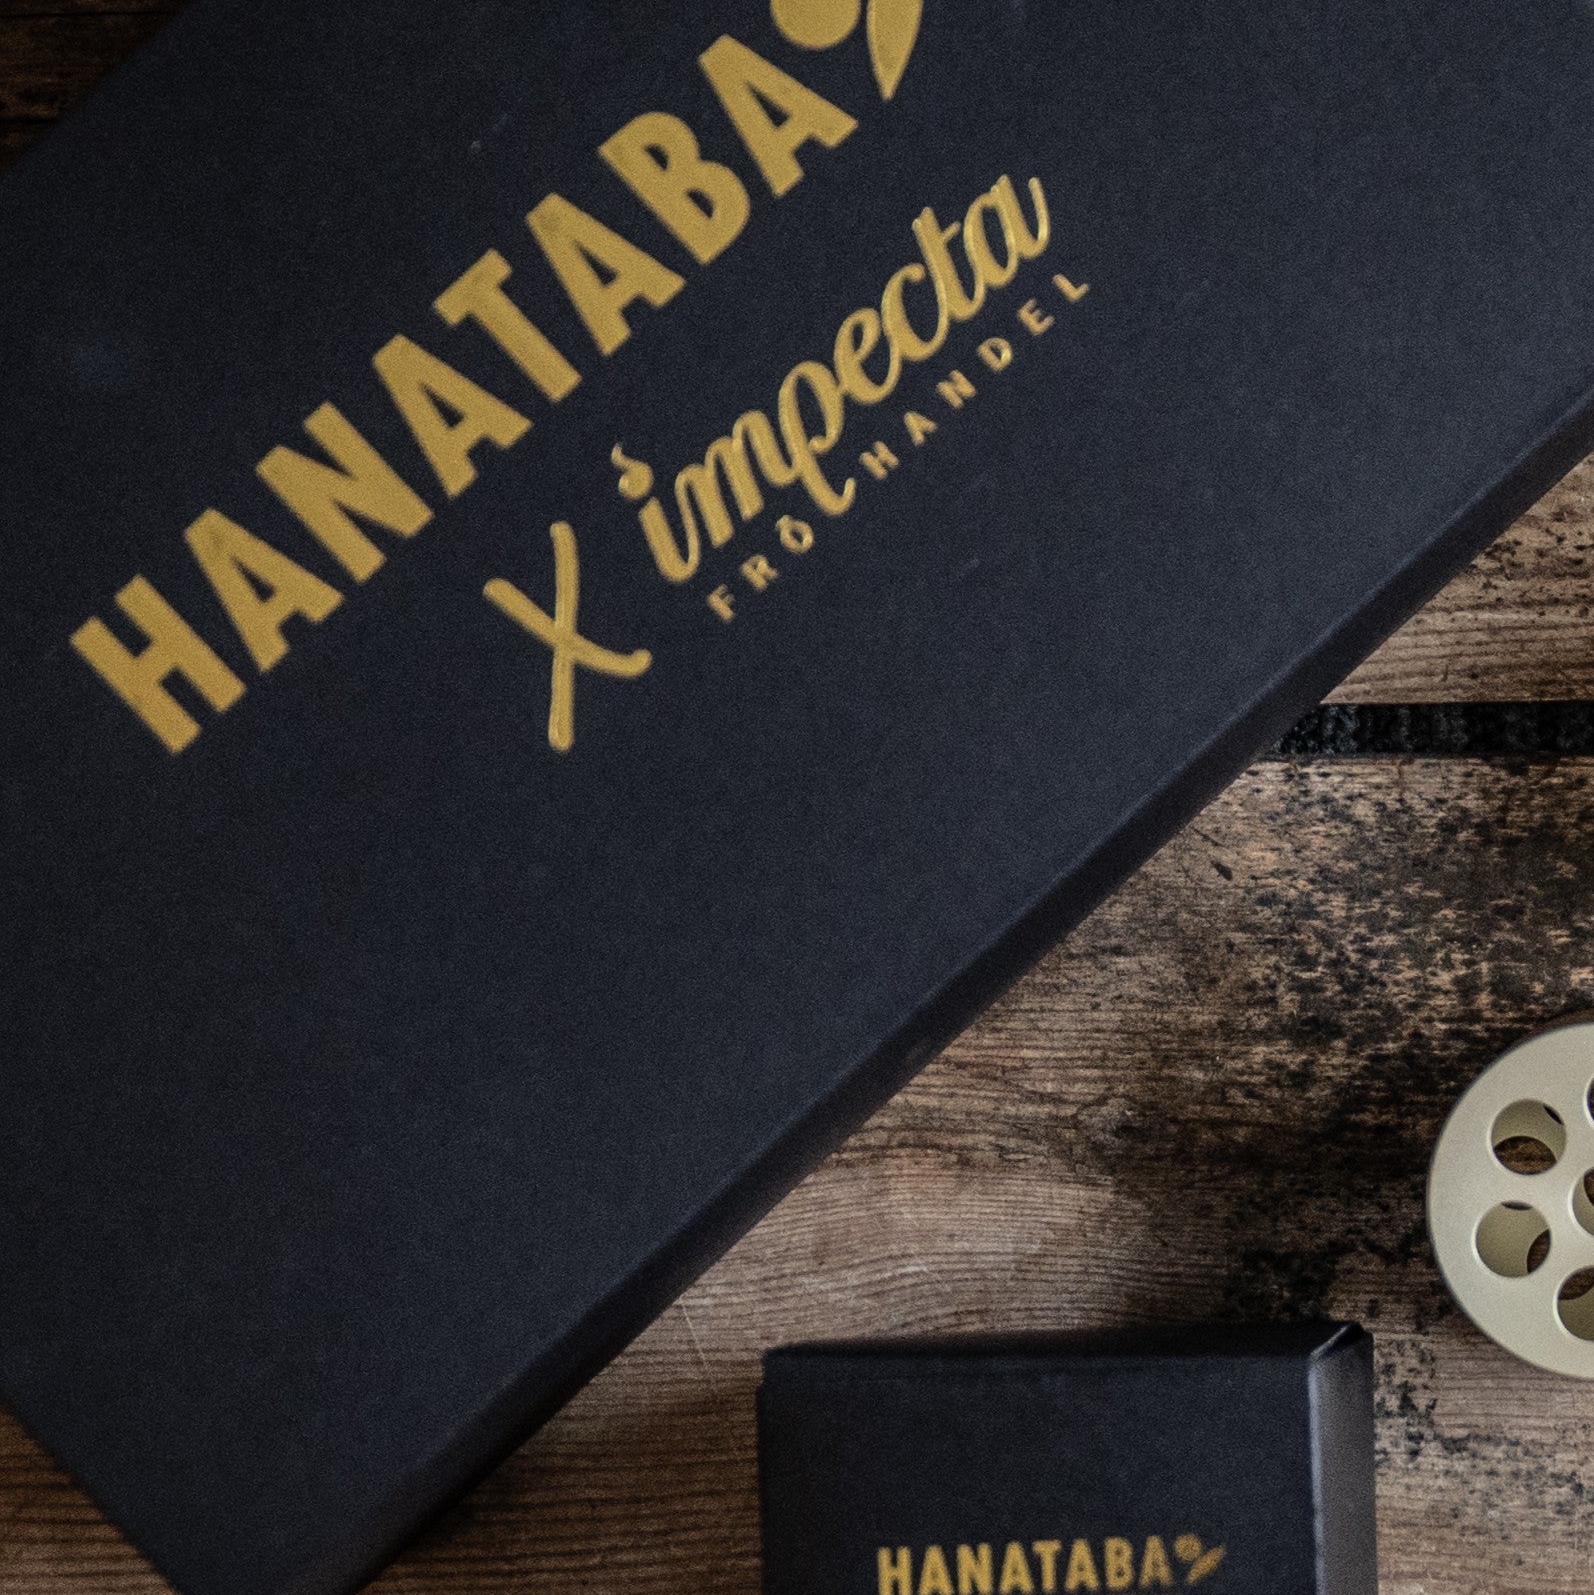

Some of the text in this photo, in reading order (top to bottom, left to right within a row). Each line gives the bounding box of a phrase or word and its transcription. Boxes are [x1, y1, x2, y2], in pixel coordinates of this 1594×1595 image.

[70, 34, 858, 754] HANATABA
[482, 173, 1051, 751] X impecta
[707, 272, 1088, 620] FRÖHANDEL
